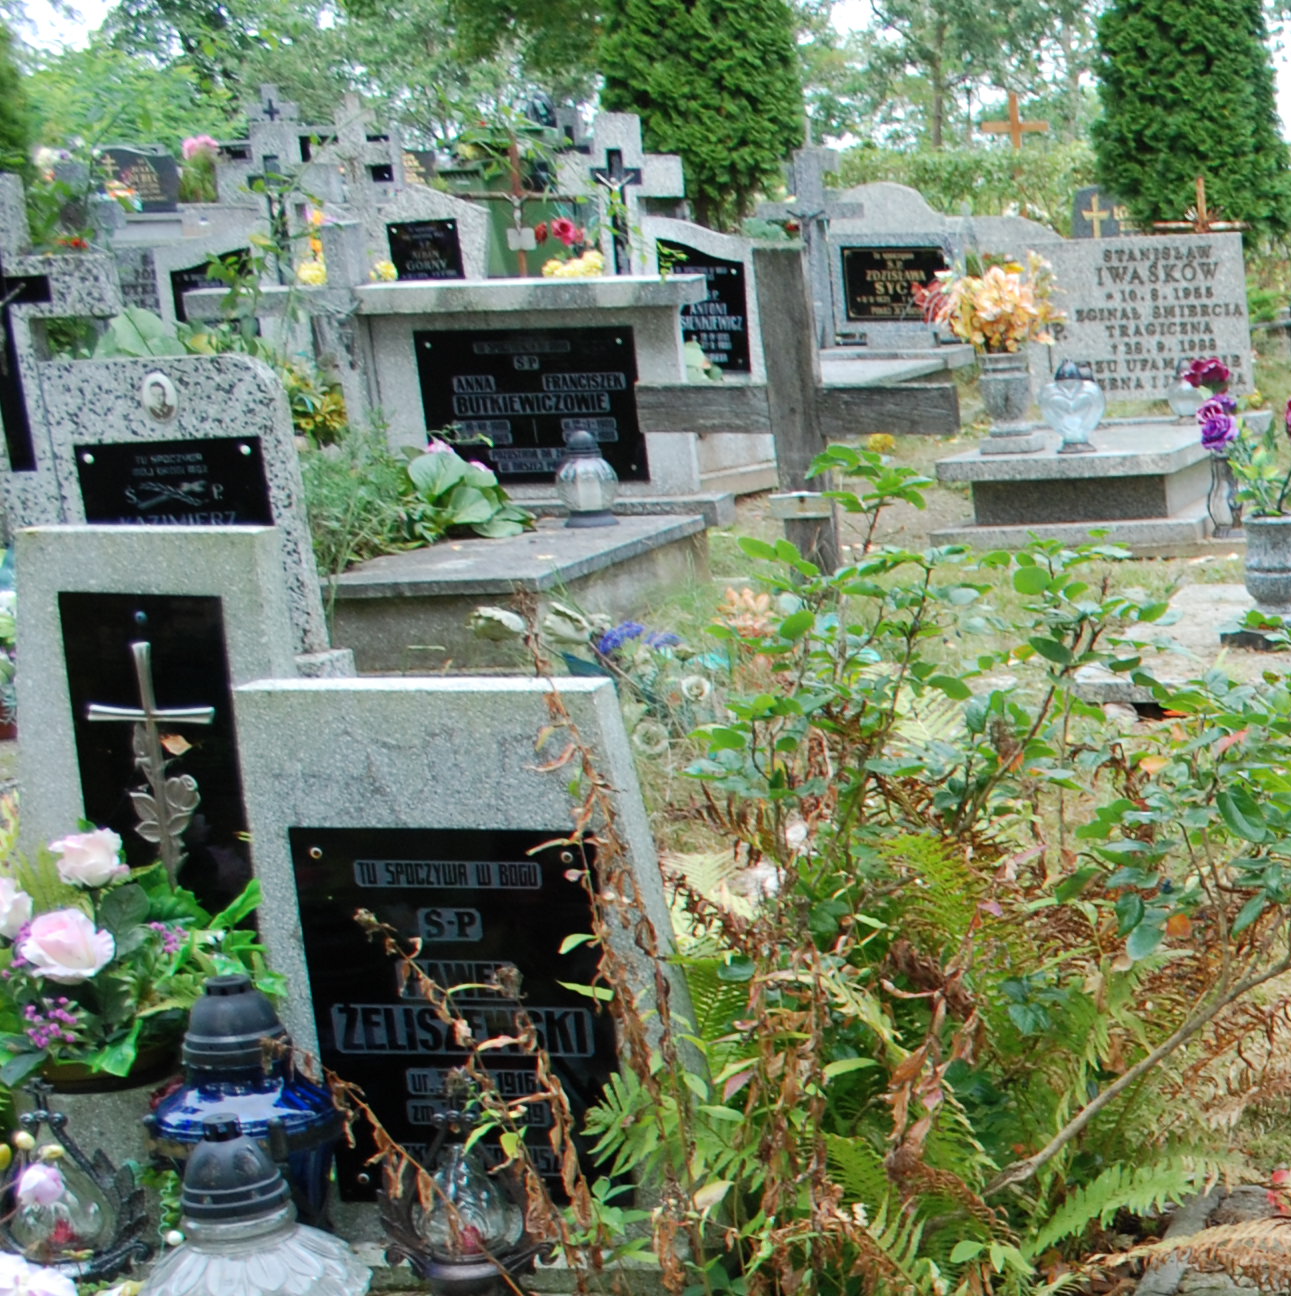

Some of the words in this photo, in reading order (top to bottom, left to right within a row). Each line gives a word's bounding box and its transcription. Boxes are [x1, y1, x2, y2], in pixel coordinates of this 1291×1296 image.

[1103, 245, 1213, 263] STANISŁAW
[456, 377, 494, 392] ANNA
[545, 373, 623, 390] FRANCISZEK
[456, 392, 607, 415] BUTKIEWICZOWIE
[358, 862, 378, 886] TU
[384, 862, 468, 887] SPOCZYWA
[499, 863, 540, 887] BOGU
